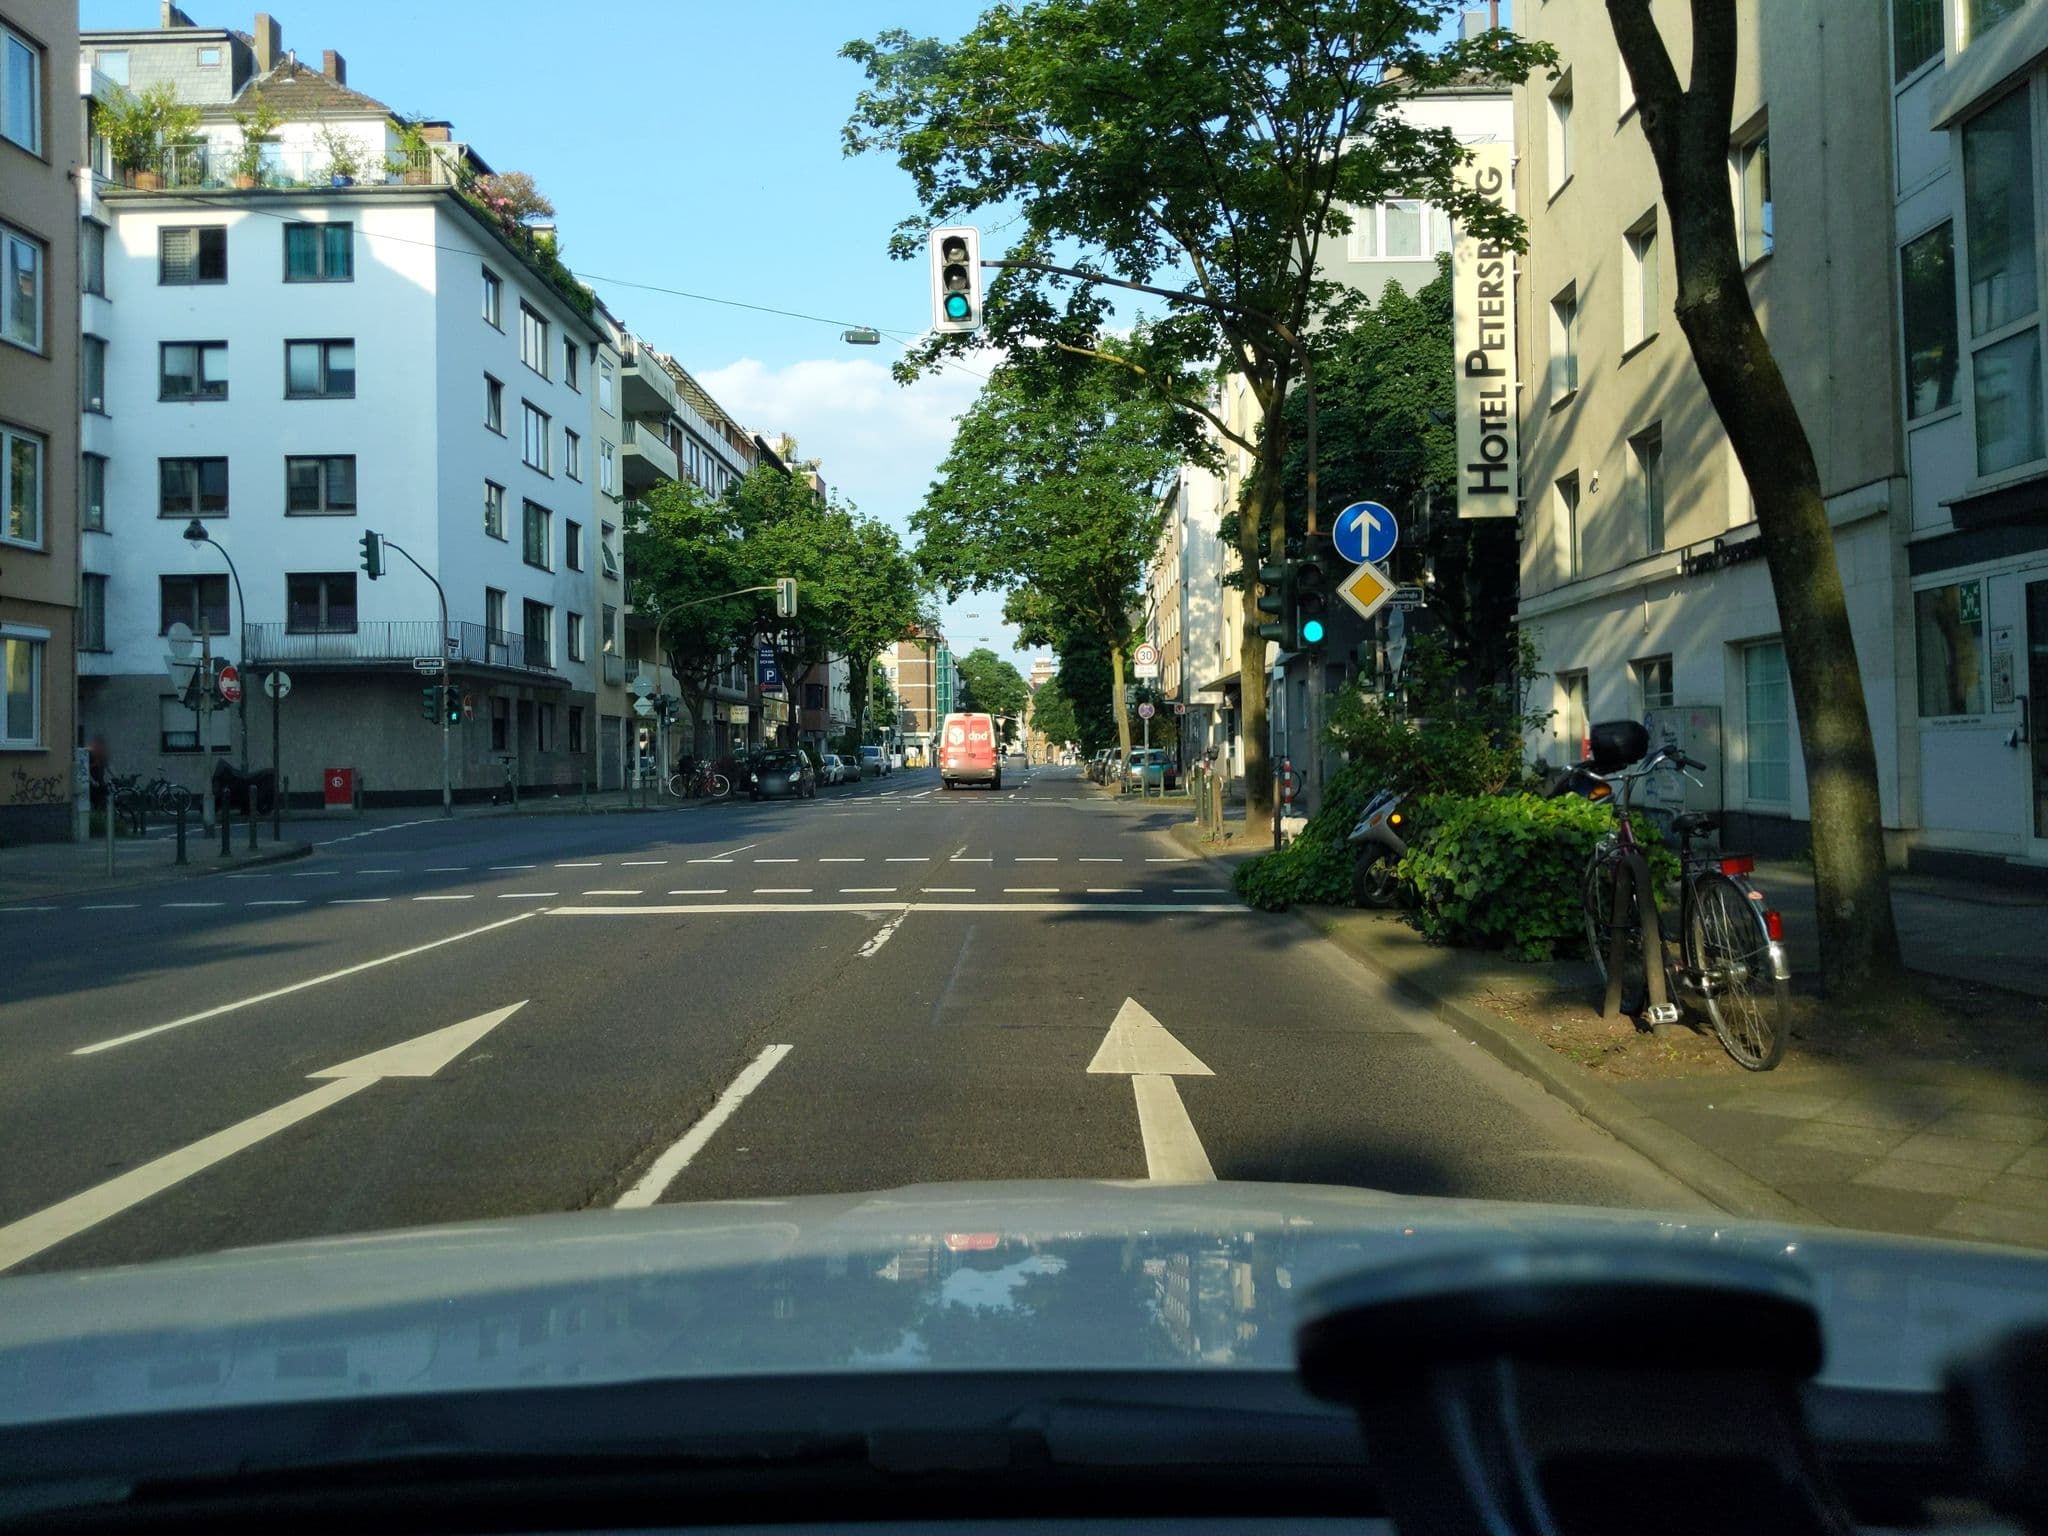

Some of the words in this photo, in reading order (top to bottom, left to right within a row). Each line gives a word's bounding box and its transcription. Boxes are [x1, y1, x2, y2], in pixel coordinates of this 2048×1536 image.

[1465, 166, 1506, 377] PETERSBG
[1140, 650, 1153, 661] 30
[766, 670, 775, 681] P
[968, 730, 988, 742] dpd
